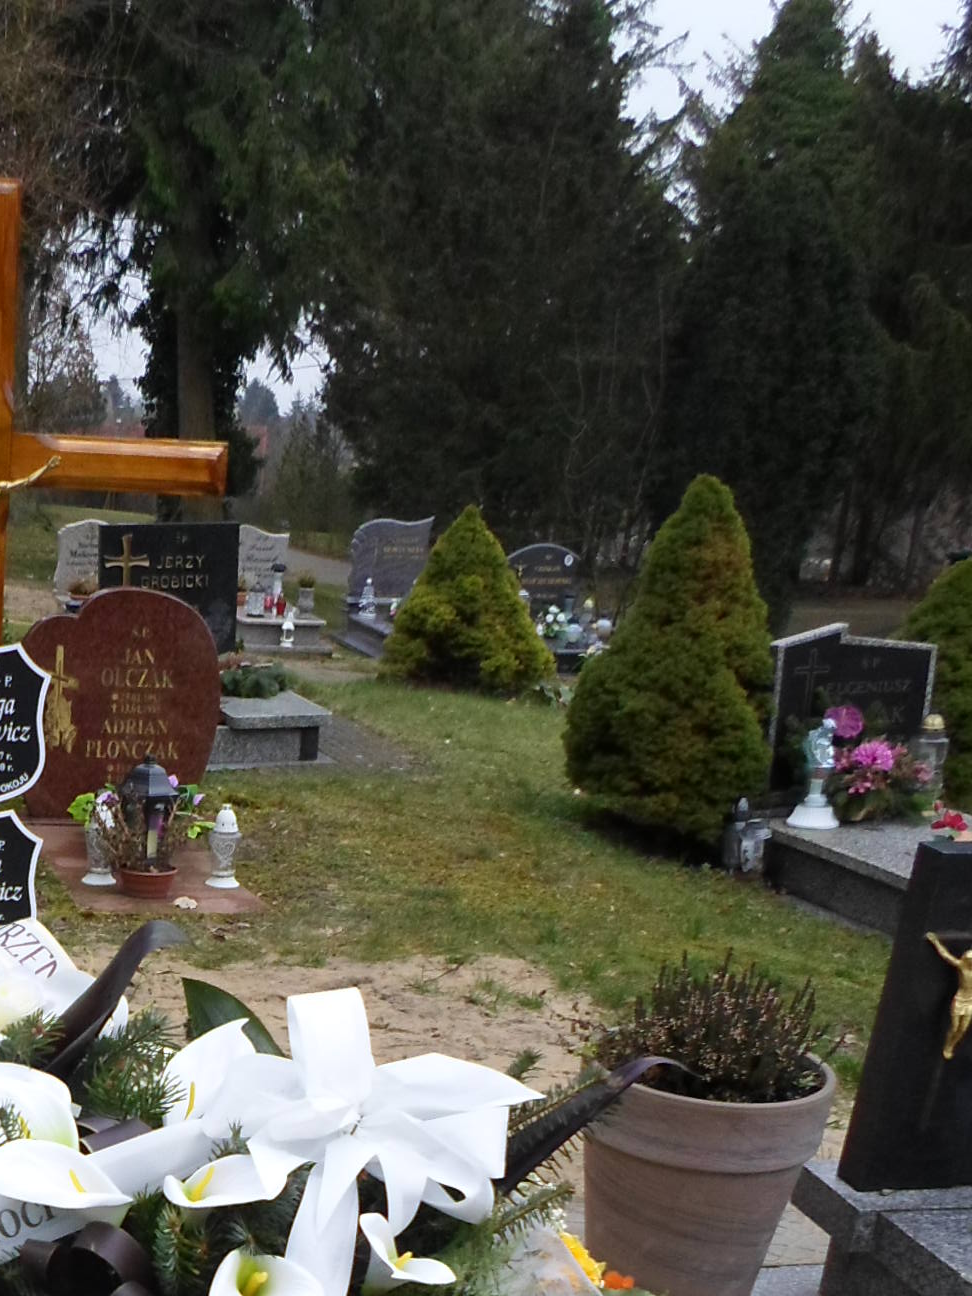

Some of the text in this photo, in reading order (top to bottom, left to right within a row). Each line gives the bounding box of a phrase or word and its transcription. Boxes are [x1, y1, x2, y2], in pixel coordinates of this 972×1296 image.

[156, 553, 205, 569] JERZY
[124, 648, 155, 665] JAN
[101, 668, 174, 689] OLCZAK
[101, 719, 169, 735] ADRIAN
